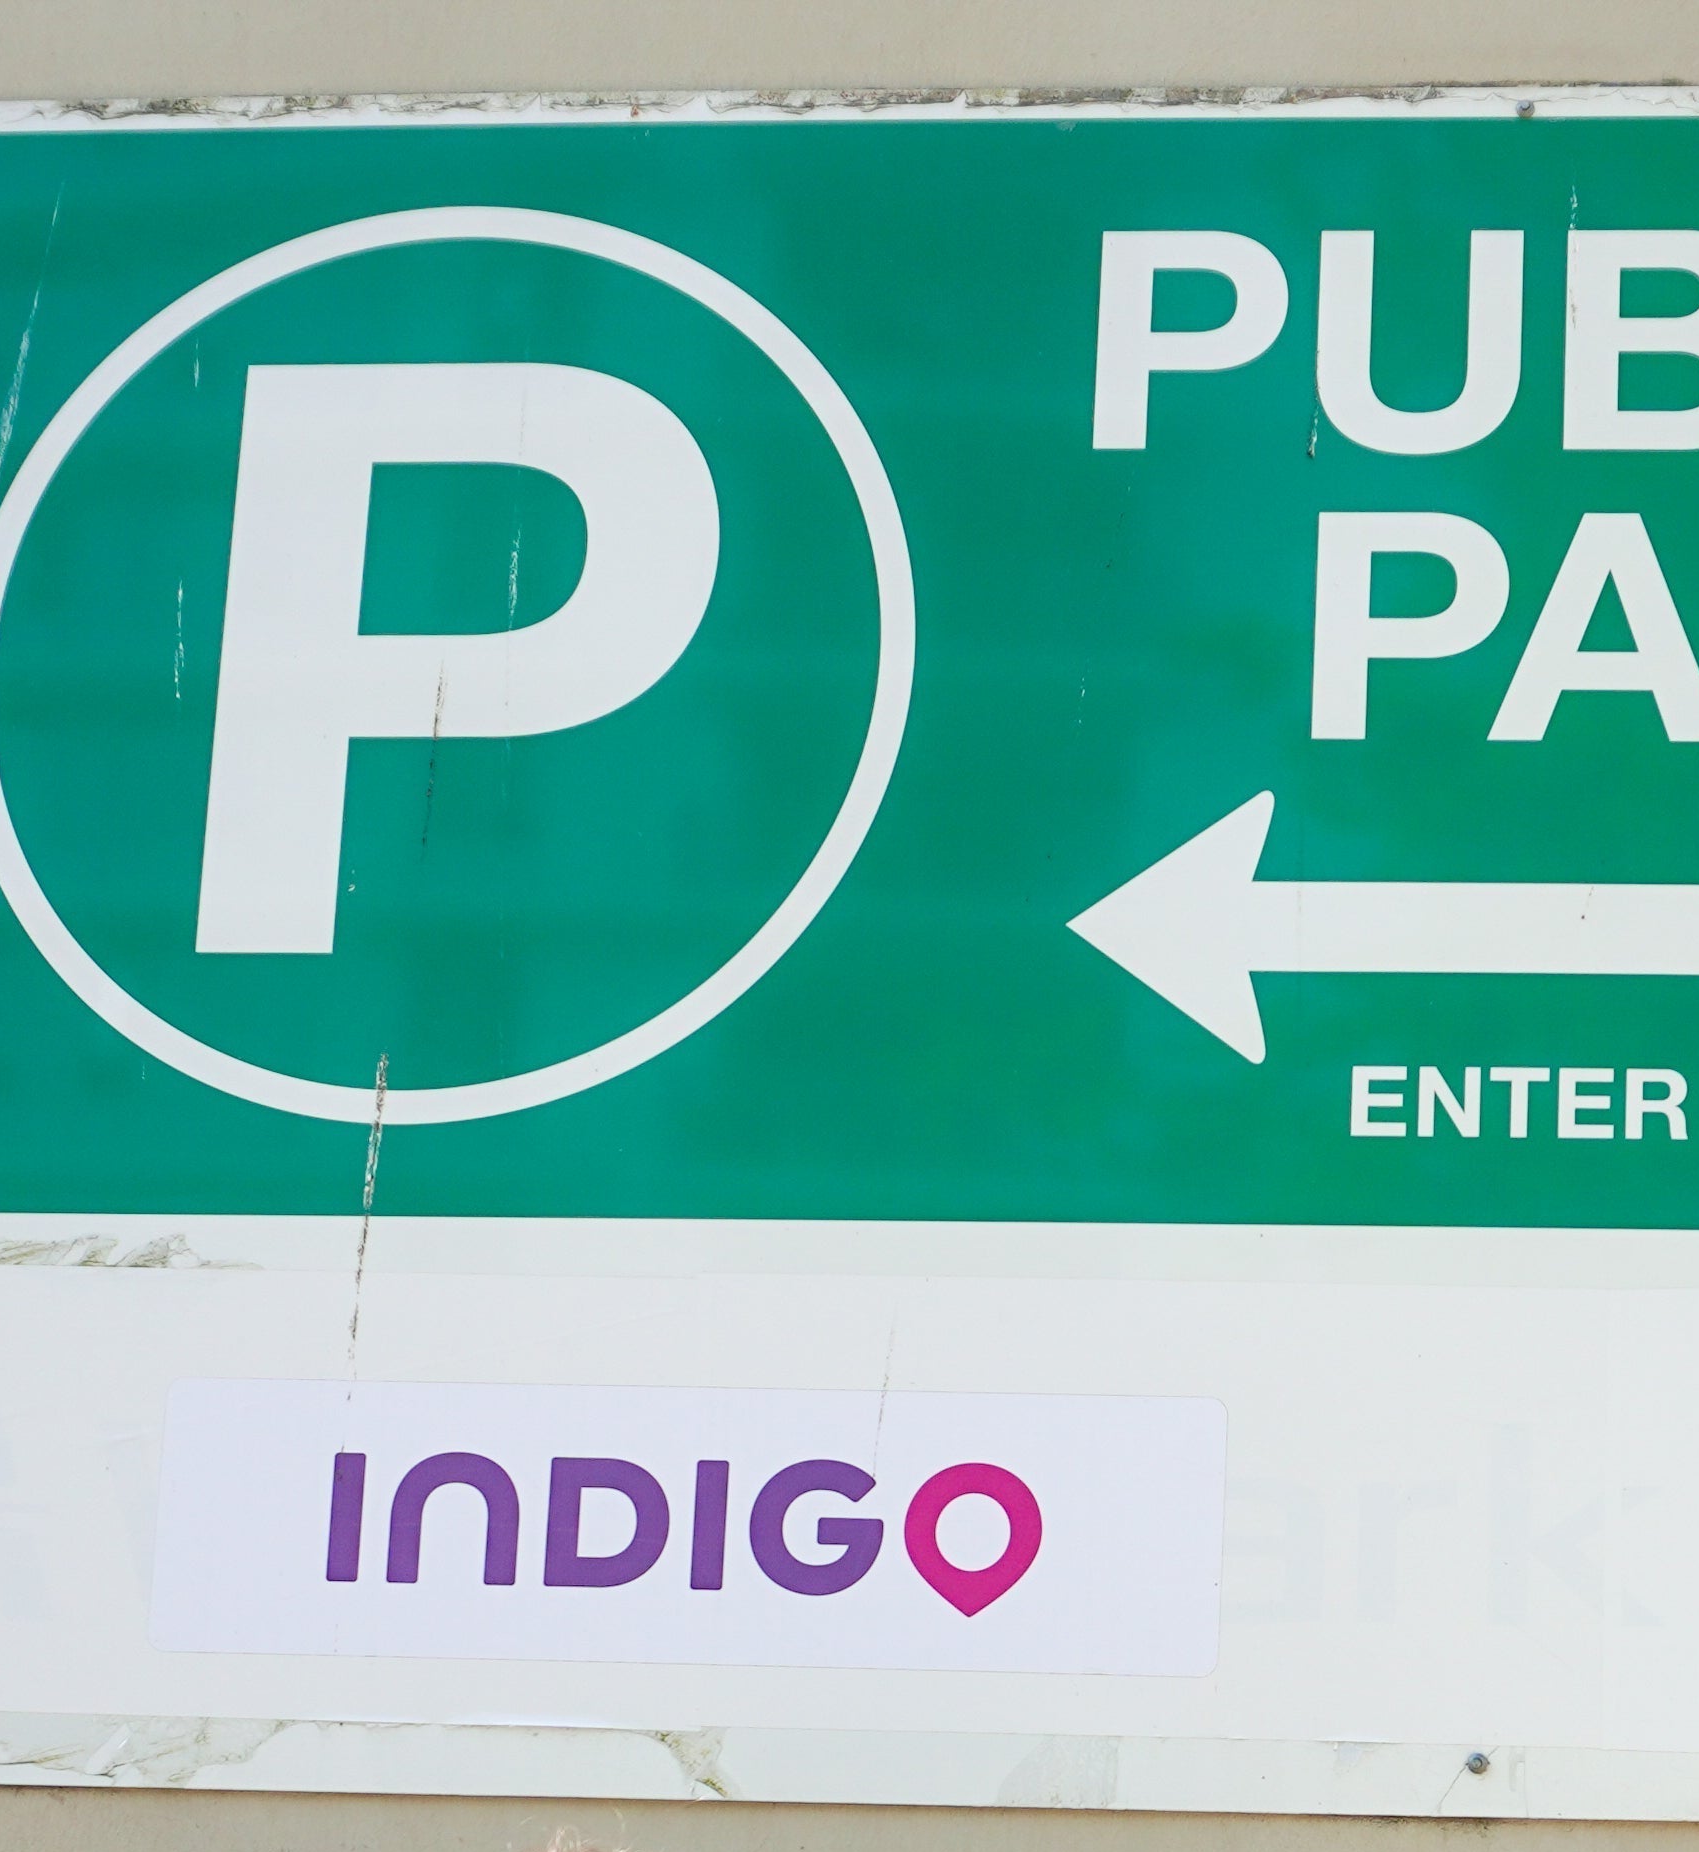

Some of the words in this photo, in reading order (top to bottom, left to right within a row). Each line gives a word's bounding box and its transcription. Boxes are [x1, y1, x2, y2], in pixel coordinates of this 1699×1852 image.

[196, 363, 719, 953] P
[1351, 1066, 1687, 1139] ENTER
[326, 1452, 1042, 1617] INDIGO
